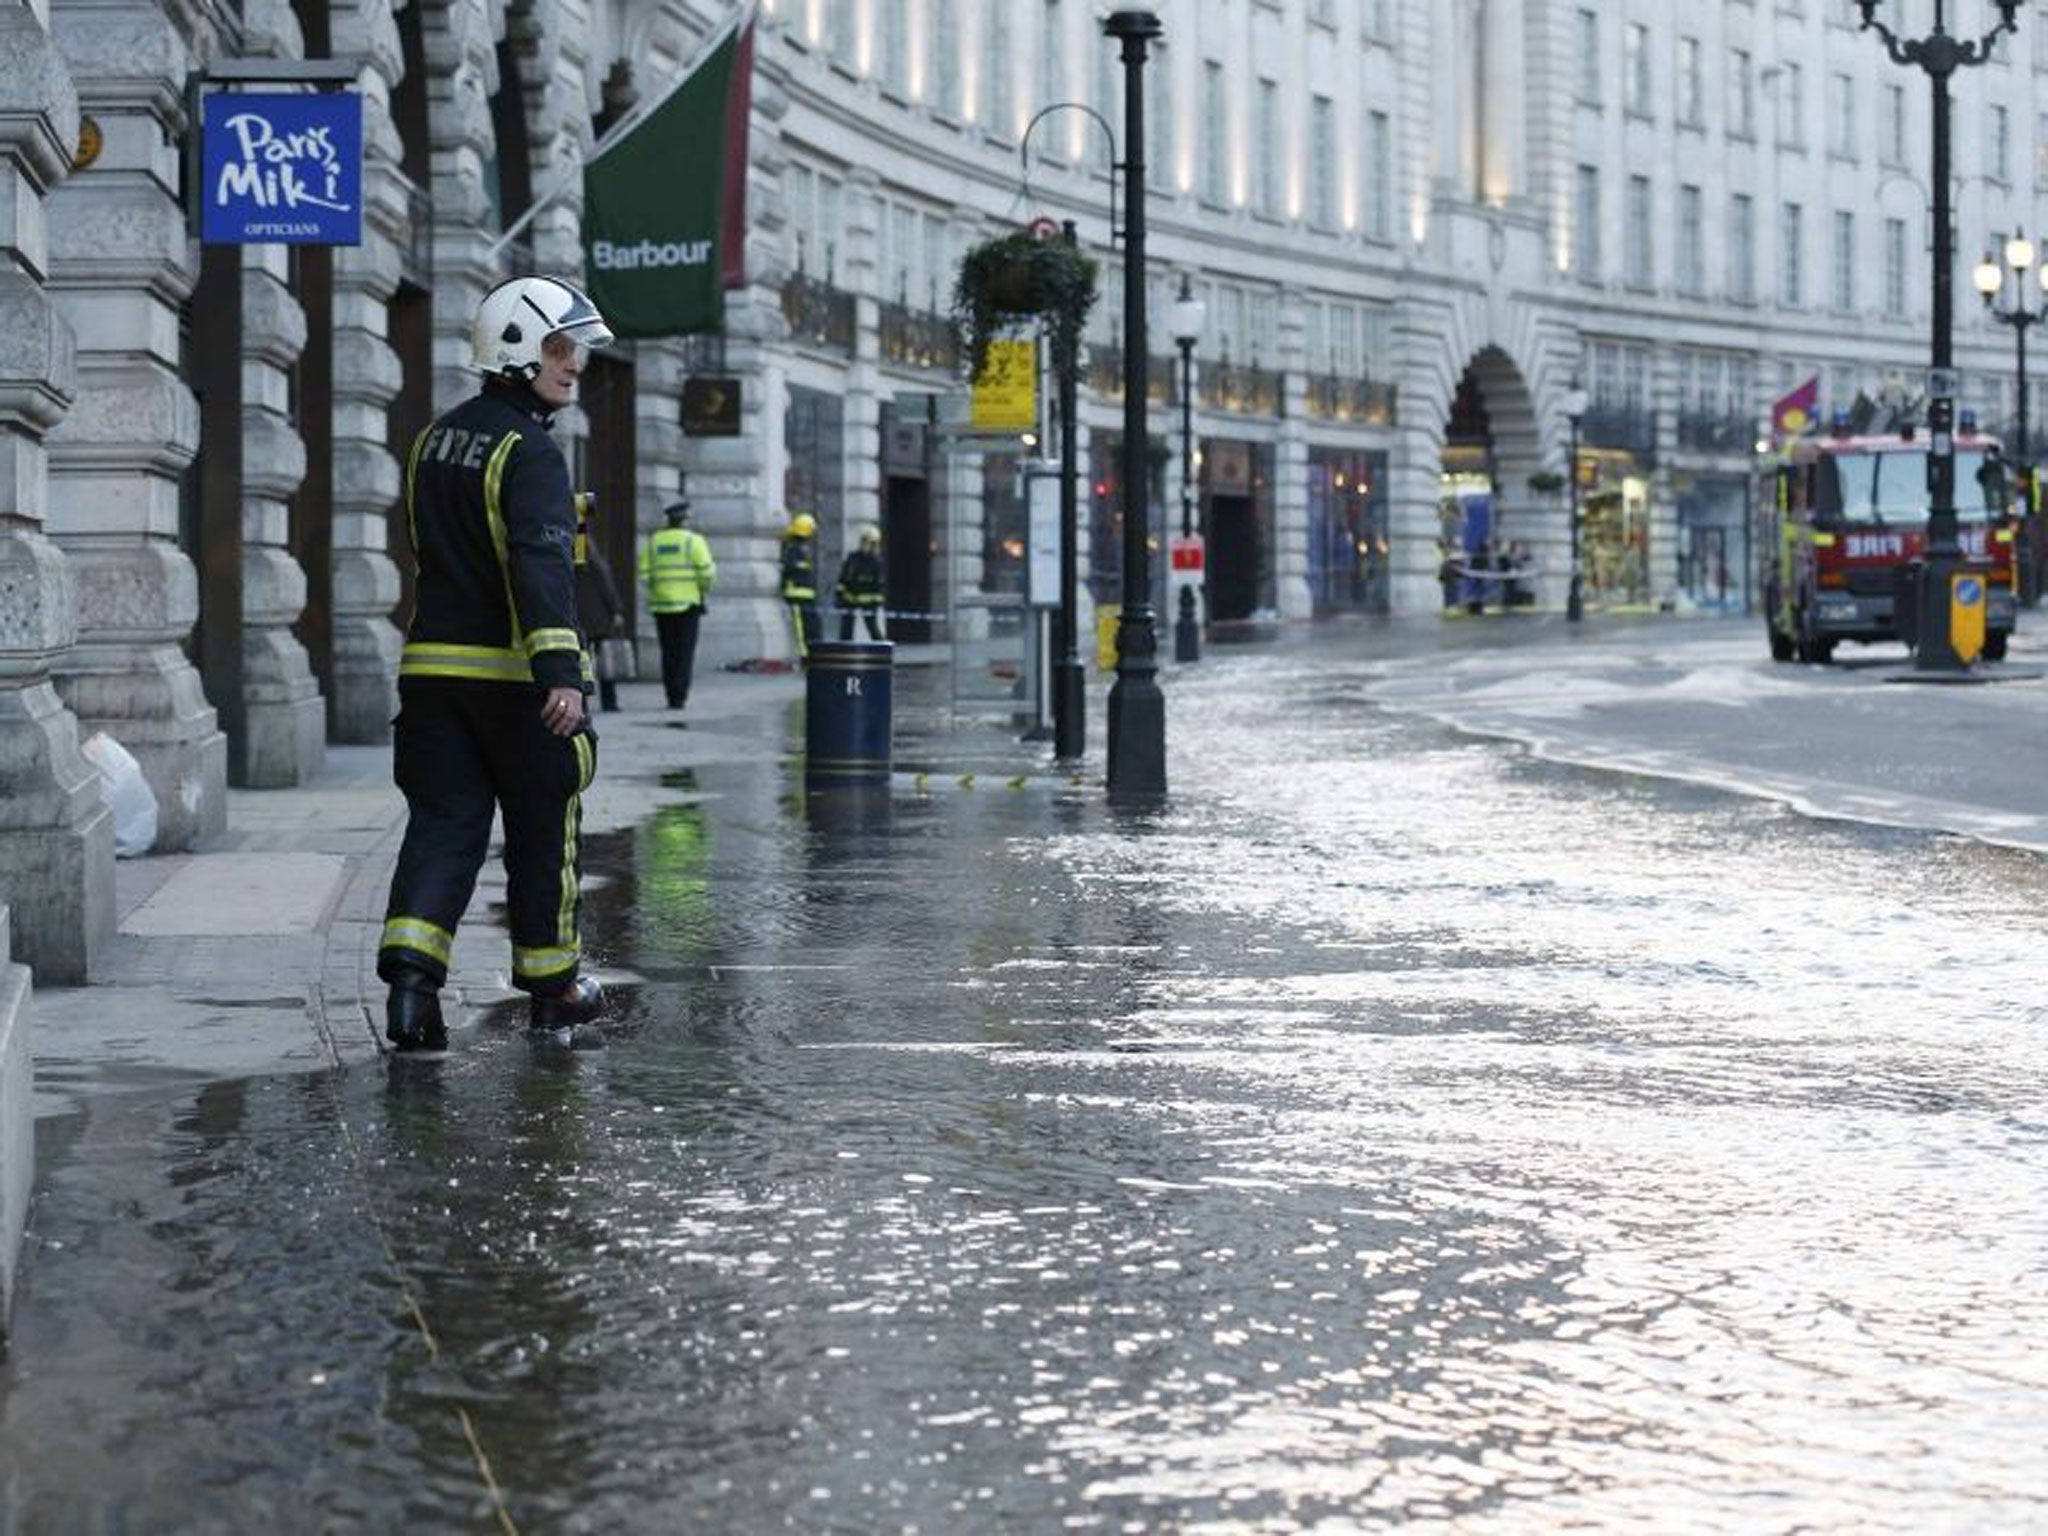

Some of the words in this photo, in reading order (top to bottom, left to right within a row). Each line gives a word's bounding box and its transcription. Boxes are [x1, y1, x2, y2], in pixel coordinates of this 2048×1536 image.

[224, 113, 337, 167] Paris
[218, 161, 351, 212] Miki
[244, 222, 320, 236] OPTICIANS
[593, 238, 712, 269] Barbour
[420, 427, 491, 469] FIRE
